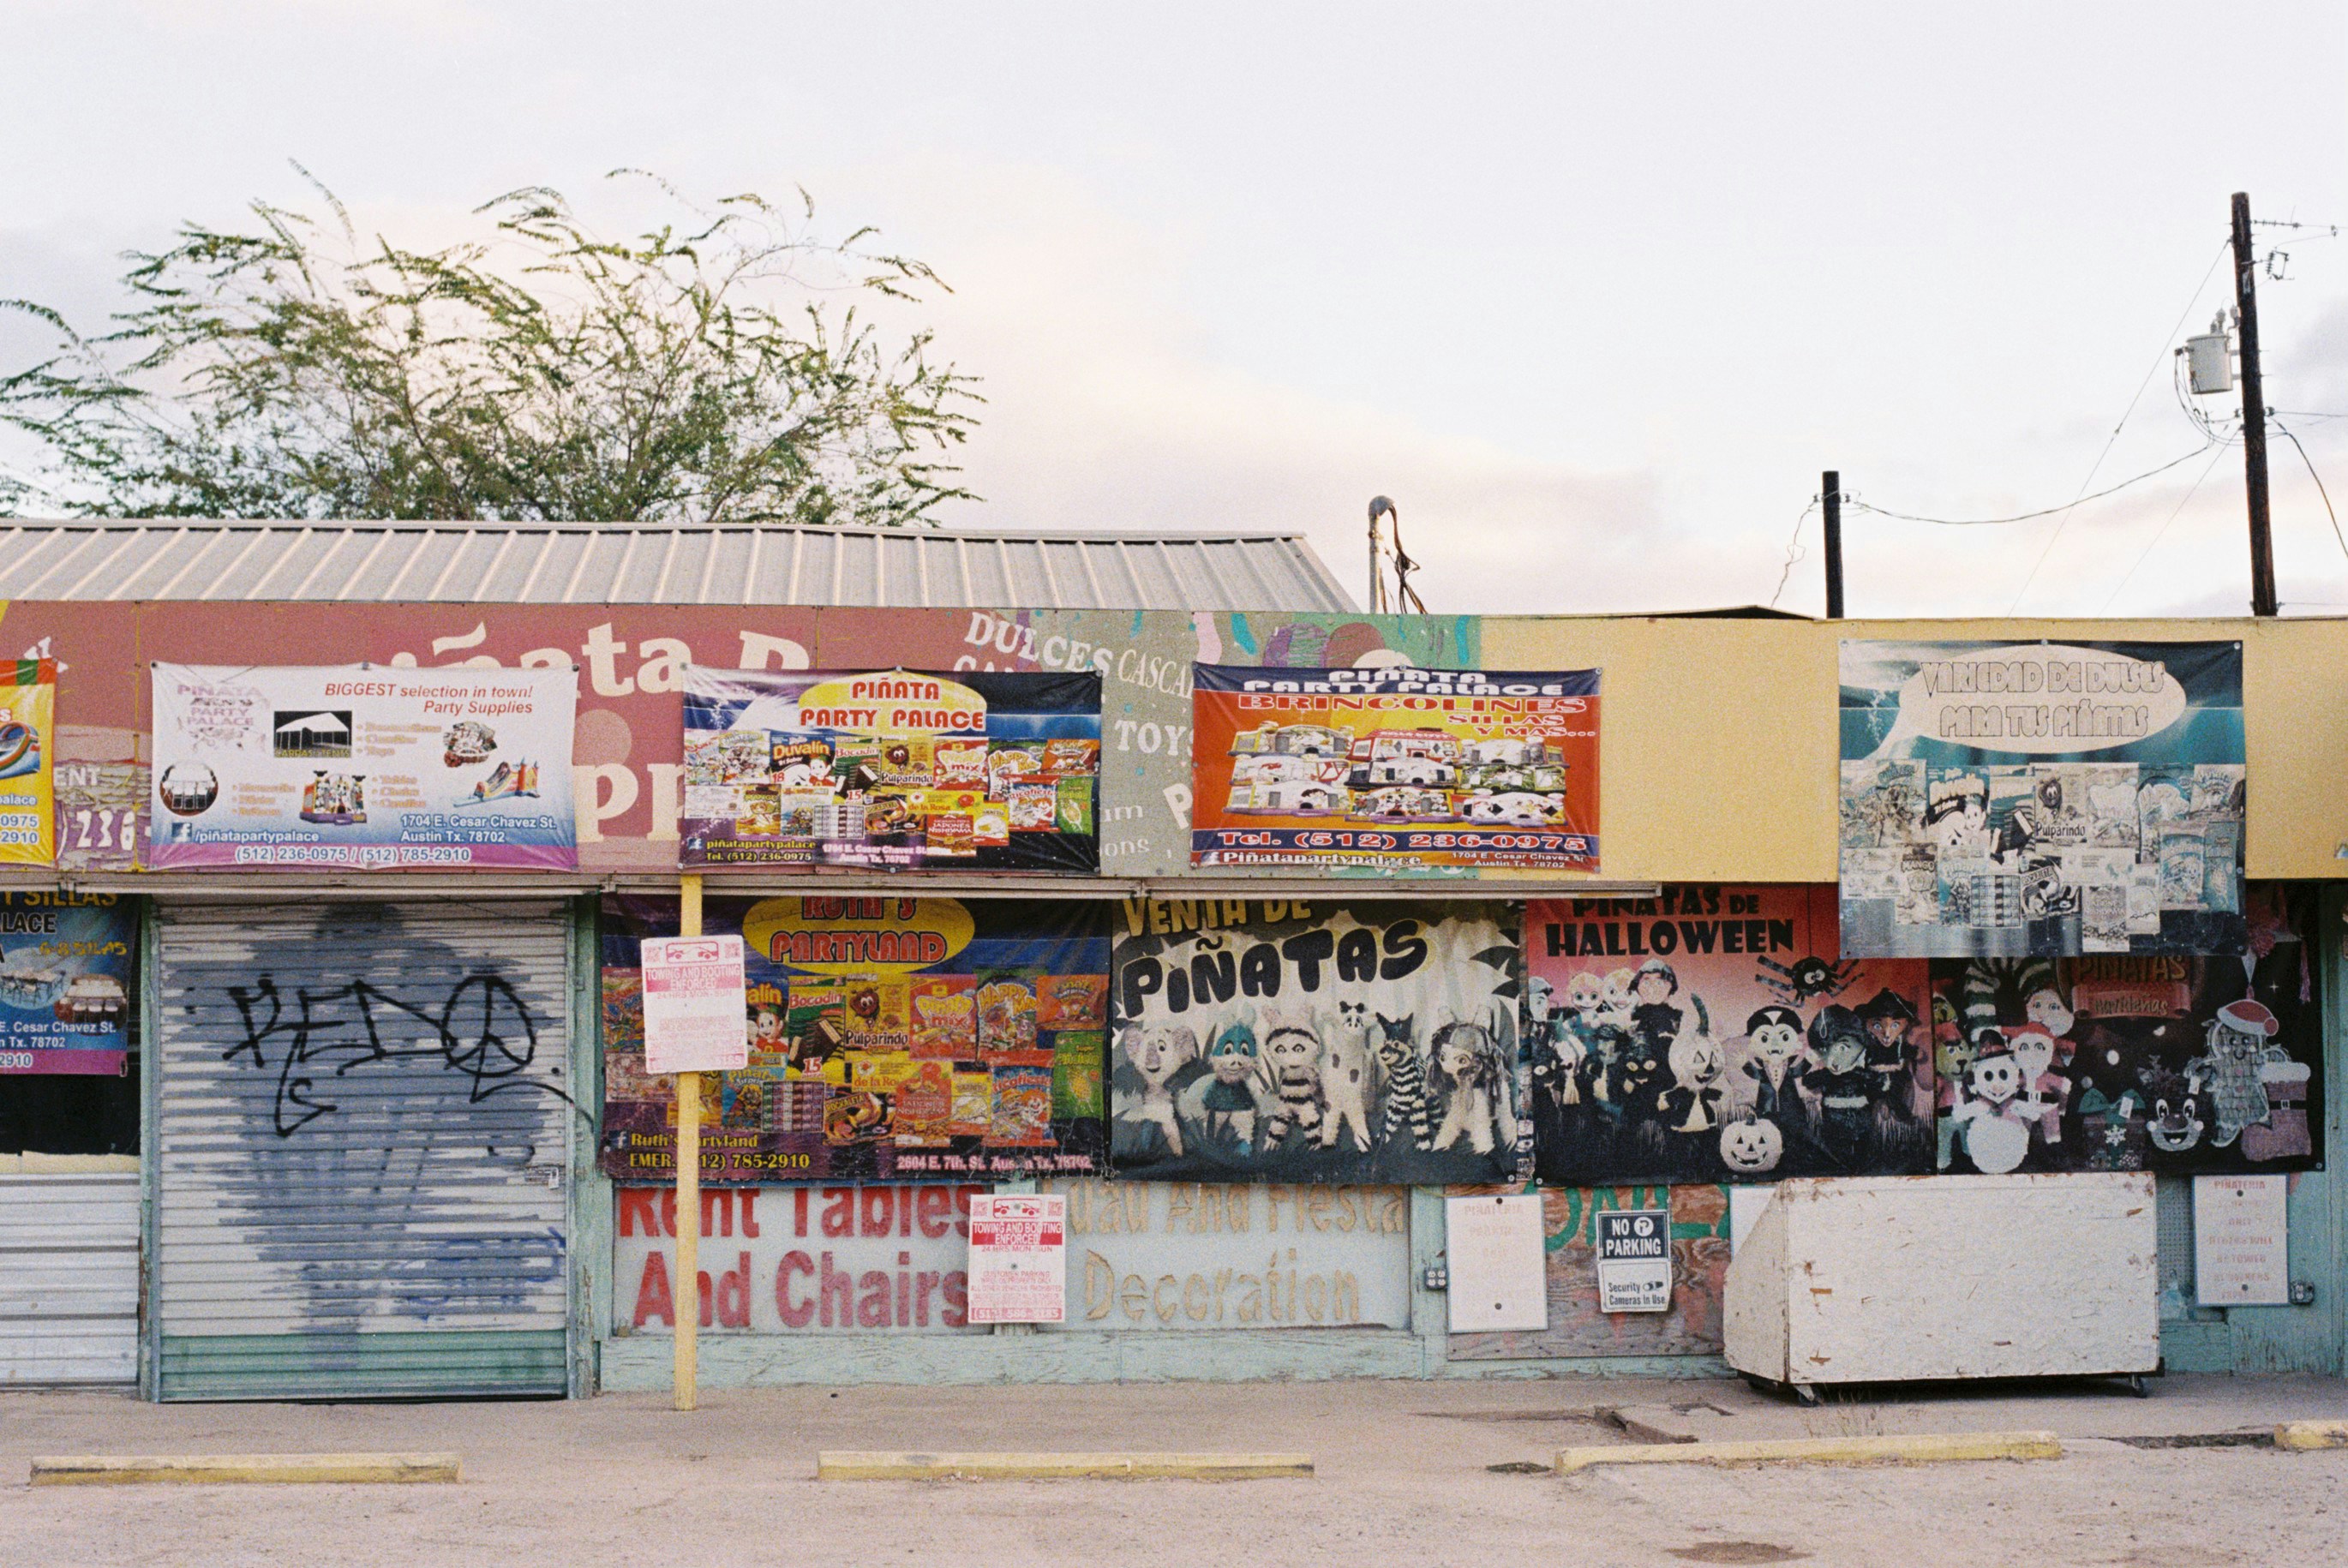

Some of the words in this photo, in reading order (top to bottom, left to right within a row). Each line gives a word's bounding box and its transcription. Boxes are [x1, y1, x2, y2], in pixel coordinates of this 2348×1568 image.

[964, 612, 1113, 679] DULCES
[2048, 661, 2081, 693] DE
[325, 682, 397, 697] BIGGEST
[400, 685, 468, 698] selection
[473, 685, 487, 698] in
[491, 685, 534, 699] town!
[852, 677, 939, 700] PIÑATA
[1243, 680, 1385, 693] PARTY
[1398, 681, 1563, 696] PALACE
[190, 707, 249, 716] PARTY
[423, 700, 464, 716] Party
[468, 700, 534, 715] Supplies
[1237, 694, 1588, 714] BRINCOLINES
[187, 717, 255, 727] PALACE
[800, 708, 878, 727] PARTY
[892, 709, 984, 729] PALACE
[1448, 714, 1565, 727] SILLAS
[1939, 705, 2003, 737] PARA
[2006, 705, 2049, 737] TUS
[1475, 727, 1493, 736] Y
[773, 741, 830, 761] Duvalín
[951, 763, 979, 772] mix
[990, 751, 1029, 769] HAPPY
[772, 773, 784, 783] 18
[881, 773, 933, 784] Pulparindo
[848, 791, 861, 801] 15
[908, 803, 919, 811] de
[401, 815, 431, 829] 1704
[434, 816, 447, 829] E.
[450, 816, 488, 829] Cesar
[490, 817, 537, 829] Chavez
[540, 817, 558, 830] St.
[2036, 821, 2086, 838] Pulparindo
[195, 830, 320, 844] /piñatapartypalace
[401, 830, 443, 843] Austin
[446, 831, 465, 843] Tx.
[468, 831, 506, 844] 78702
[706, 838, 816, 851] piñatapartypalace
[1218, 831, 1280, 846] Tel.
[1295, 832, 1396, 850] (512)
[1408, 834, 1586, 851] 236-0975
[236, 847, 275, 863] (512)
[279, 847, 347, 861] 236-0975
[360, 848, 398, 864] (512)
[402, 848, 470, 863] 785-2910
[705, 851, 724, 861] Tel.
[728, 851, 758, 863] (512)
[760, 851, 812, 862] 236-0975
[855, 845, 881, 854] Cesar
[882, 845, 914, 855] Chavez
[1531, 853, 1571, 862] Chavez
[884, 854, 911, 865] 78702
[1223, 851, 1422, 866] Piñatapartypalace
[1474, 859, 1509, 867] Austin
[1532, 860, 1566, 869] 78702
[24, 891, 118, 907] SILLAS
[1728, 894, 1759, 914] DE
[1123, 900, 1248, 937] VENTA
[1263, 900, 1312, 923] DE
[1545, 919, 1794, 957] HALLOWEEN
[770, 931, 948, 963] PARTYLAND
[646, 967, 681, 980] TOWING
[681, 967, 701, 979] AND
[702, 965, 740, 978] BOOTING
[1121, 918, 1428, 1019] PIÑATAS
[669, 978, 716, 990] ENFORCED
[789, 990, 842, 1008] Bocadin
[979, 984, 1029, 1017] HAPPY
[13, 1021, 49, 1033] Cesar
[52, 1021, 97, 1033] Chavez
[99, 1021, 117, 1033] St.
[931, 1014, 967, 1026] mix
[9, 1037, 27, 1048] Tx.
[31, 1037, 65, 1048] 78702
[846, 1030, 908, 1047] Pulparindo
[803, 1056, 822, 1072] 15
[854, 1076, 867, 1087] de
[870, 1076, 880, 1087] la
[630, 1152, 676, 1168] EMER.
[732, 1153, 811, 1169] 785-2910
[896, 1155, 927, 1170] 2604
[928, 1156, 941, 1170] E.
[794, 1185, 975, 1238] Tables
[973, 1222, 1005, 1234] TOWING
[1006, 1222, 1024, 1234] AND
[1026, 1222, 1063, 1234] BOOTING
[1611, 1218, 1630, 1236] NO
[995, 1233, 1040, 1245] ENFORCED
[1605, 1239, 1662, 1256] PARKING
[775, 1250, 969, 1327] Chairs
[1084, 1248, 1361, 1323] Decoration
[1608, 1281, 1641, 1295] Security
[1608, 1294, 1641, 1306] Cameras
[1651, 1294, 1665, 1305] Use
